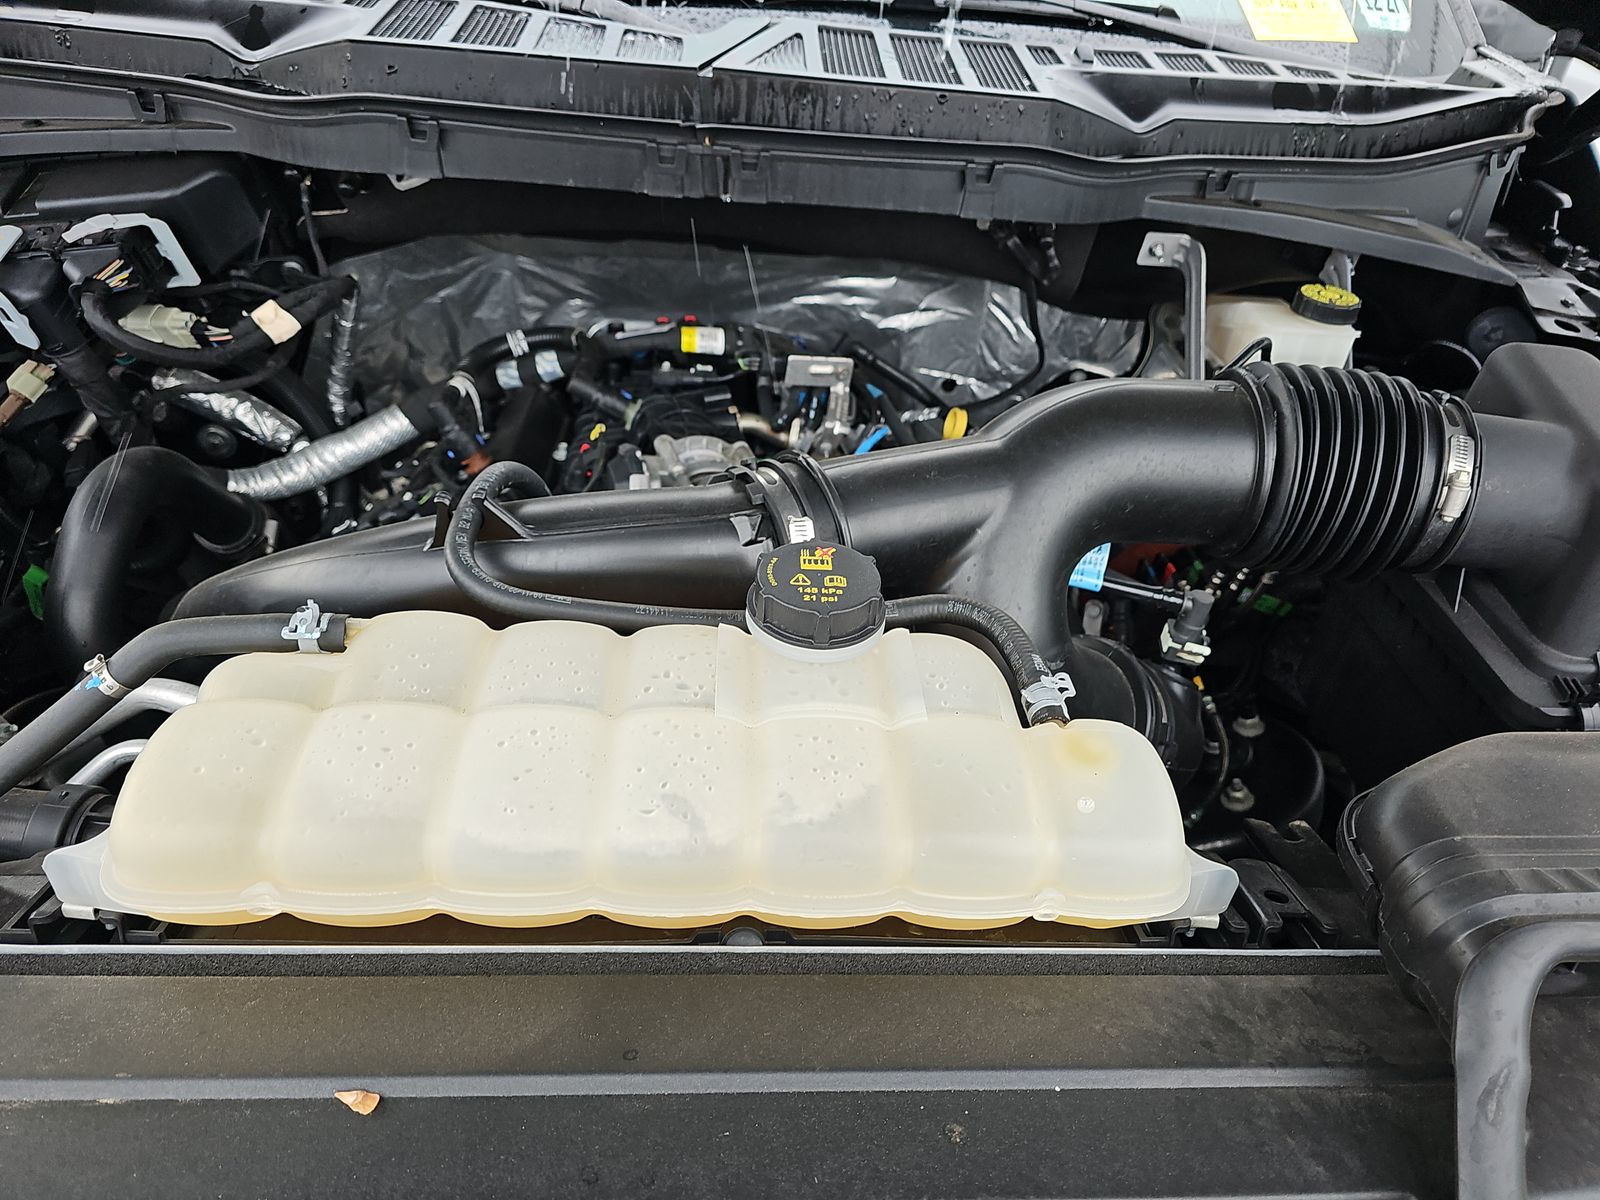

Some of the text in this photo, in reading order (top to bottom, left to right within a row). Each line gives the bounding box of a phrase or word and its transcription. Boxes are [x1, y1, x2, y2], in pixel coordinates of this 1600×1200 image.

[797, 586, 844, 595] 145 kPa
[803, 594, 838, 603] 21 psi
